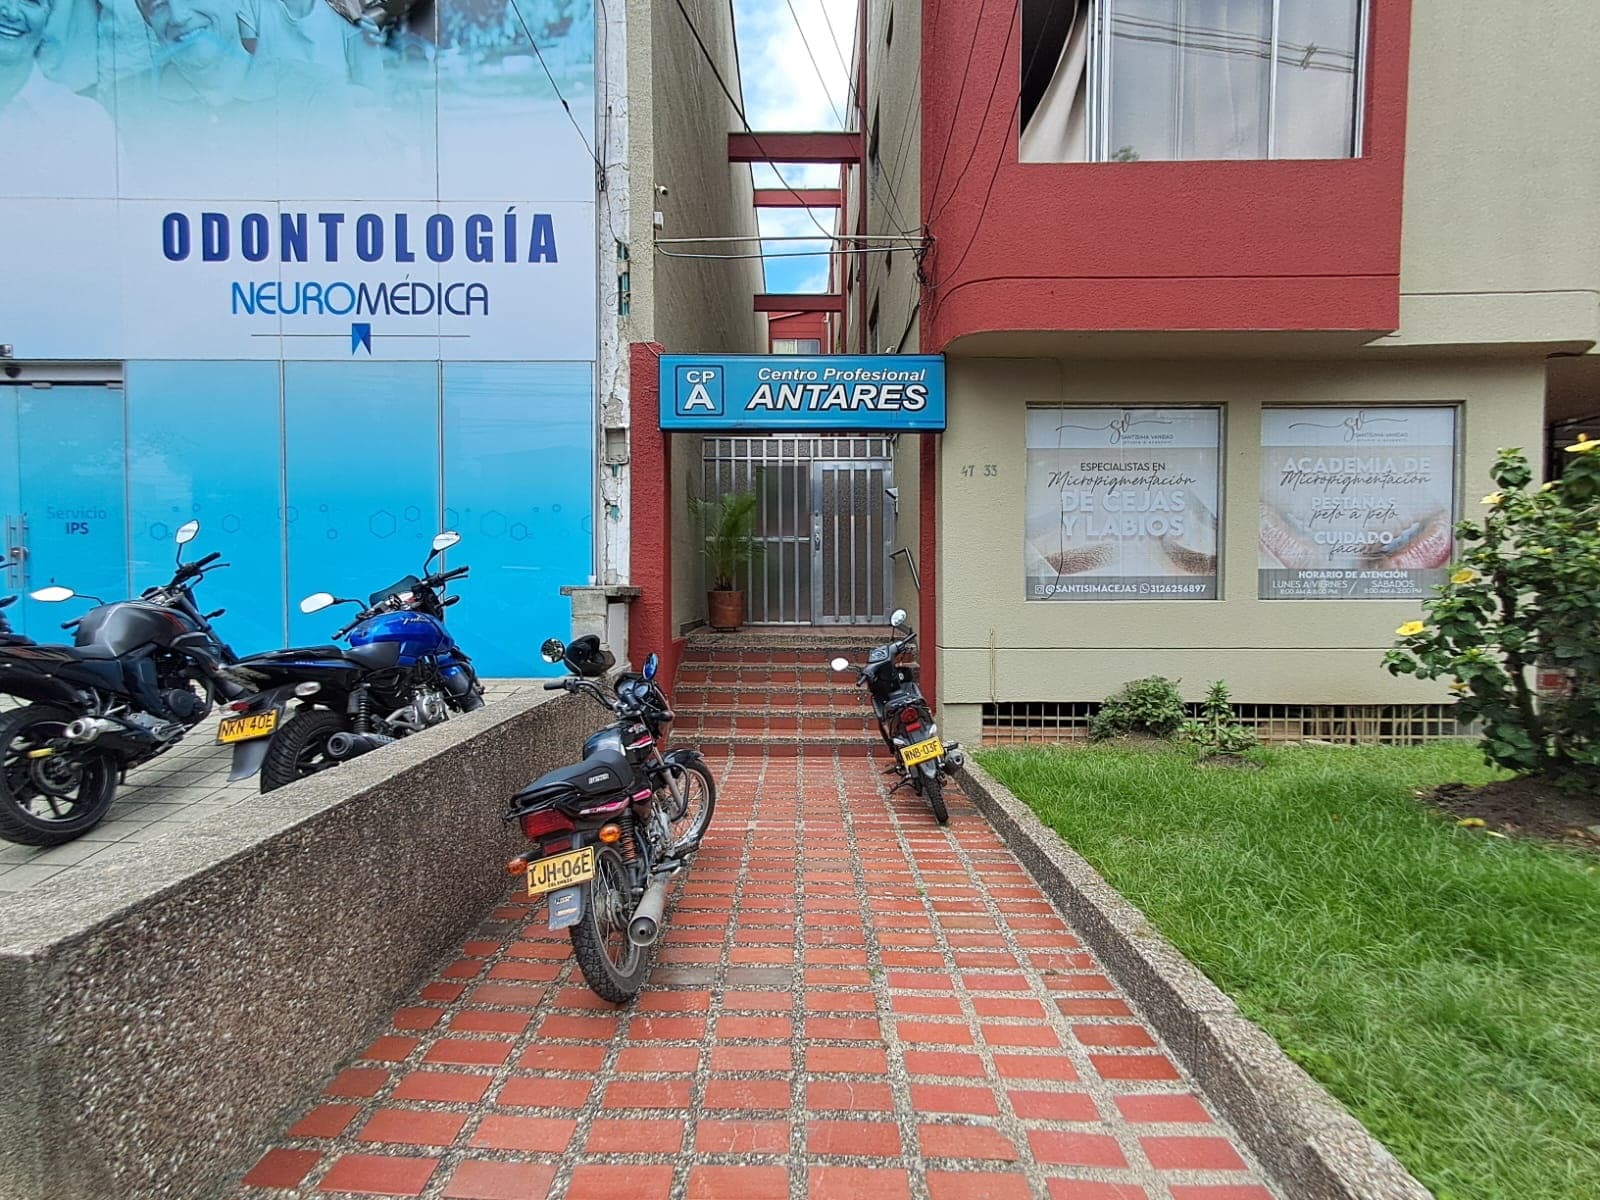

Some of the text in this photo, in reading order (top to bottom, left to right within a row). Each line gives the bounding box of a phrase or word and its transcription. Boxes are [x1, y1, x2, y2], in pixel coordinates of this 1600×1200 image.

[162, 206, 559, 263] ODONTOLOGÍA
[231, 274, 489, 316] NEUROMÉDICA
[686, 370, 715, 384] CP
[757, 367, 926, 382] Centro Profesional
[683, 384, 717, 411] A
[745, 383, 929, 412] ANTARES
[983, 464, 998, 477] 33
[1080, 462, 1166, 472] ESPECIALISTAS EN
[1282, 456, 1433, 474] ACADEMIA DE
[1048, 470, 1197, 495] Micropigmentación
[1280, 469, 1432, 494] Micropigmentación
[1061, 490, 1186, 513] DE CEJAS
[46, 506, 107, 520] Servicio
[65, 522, 90, 535] IPS
[1062, 515, 1185, 538] Y LABIOS
[1313, 530, 1394, 545] CUIDADO
[1298, 569, 1409, 579] HORARIO DE ATENCIÓN
[1045, 584, 1207, 594] @SANTISIMACEJAS 3126256897
[1272, 580, 1301, 589] LUNES
[1311, 580, 1348, 588] VIERNES
